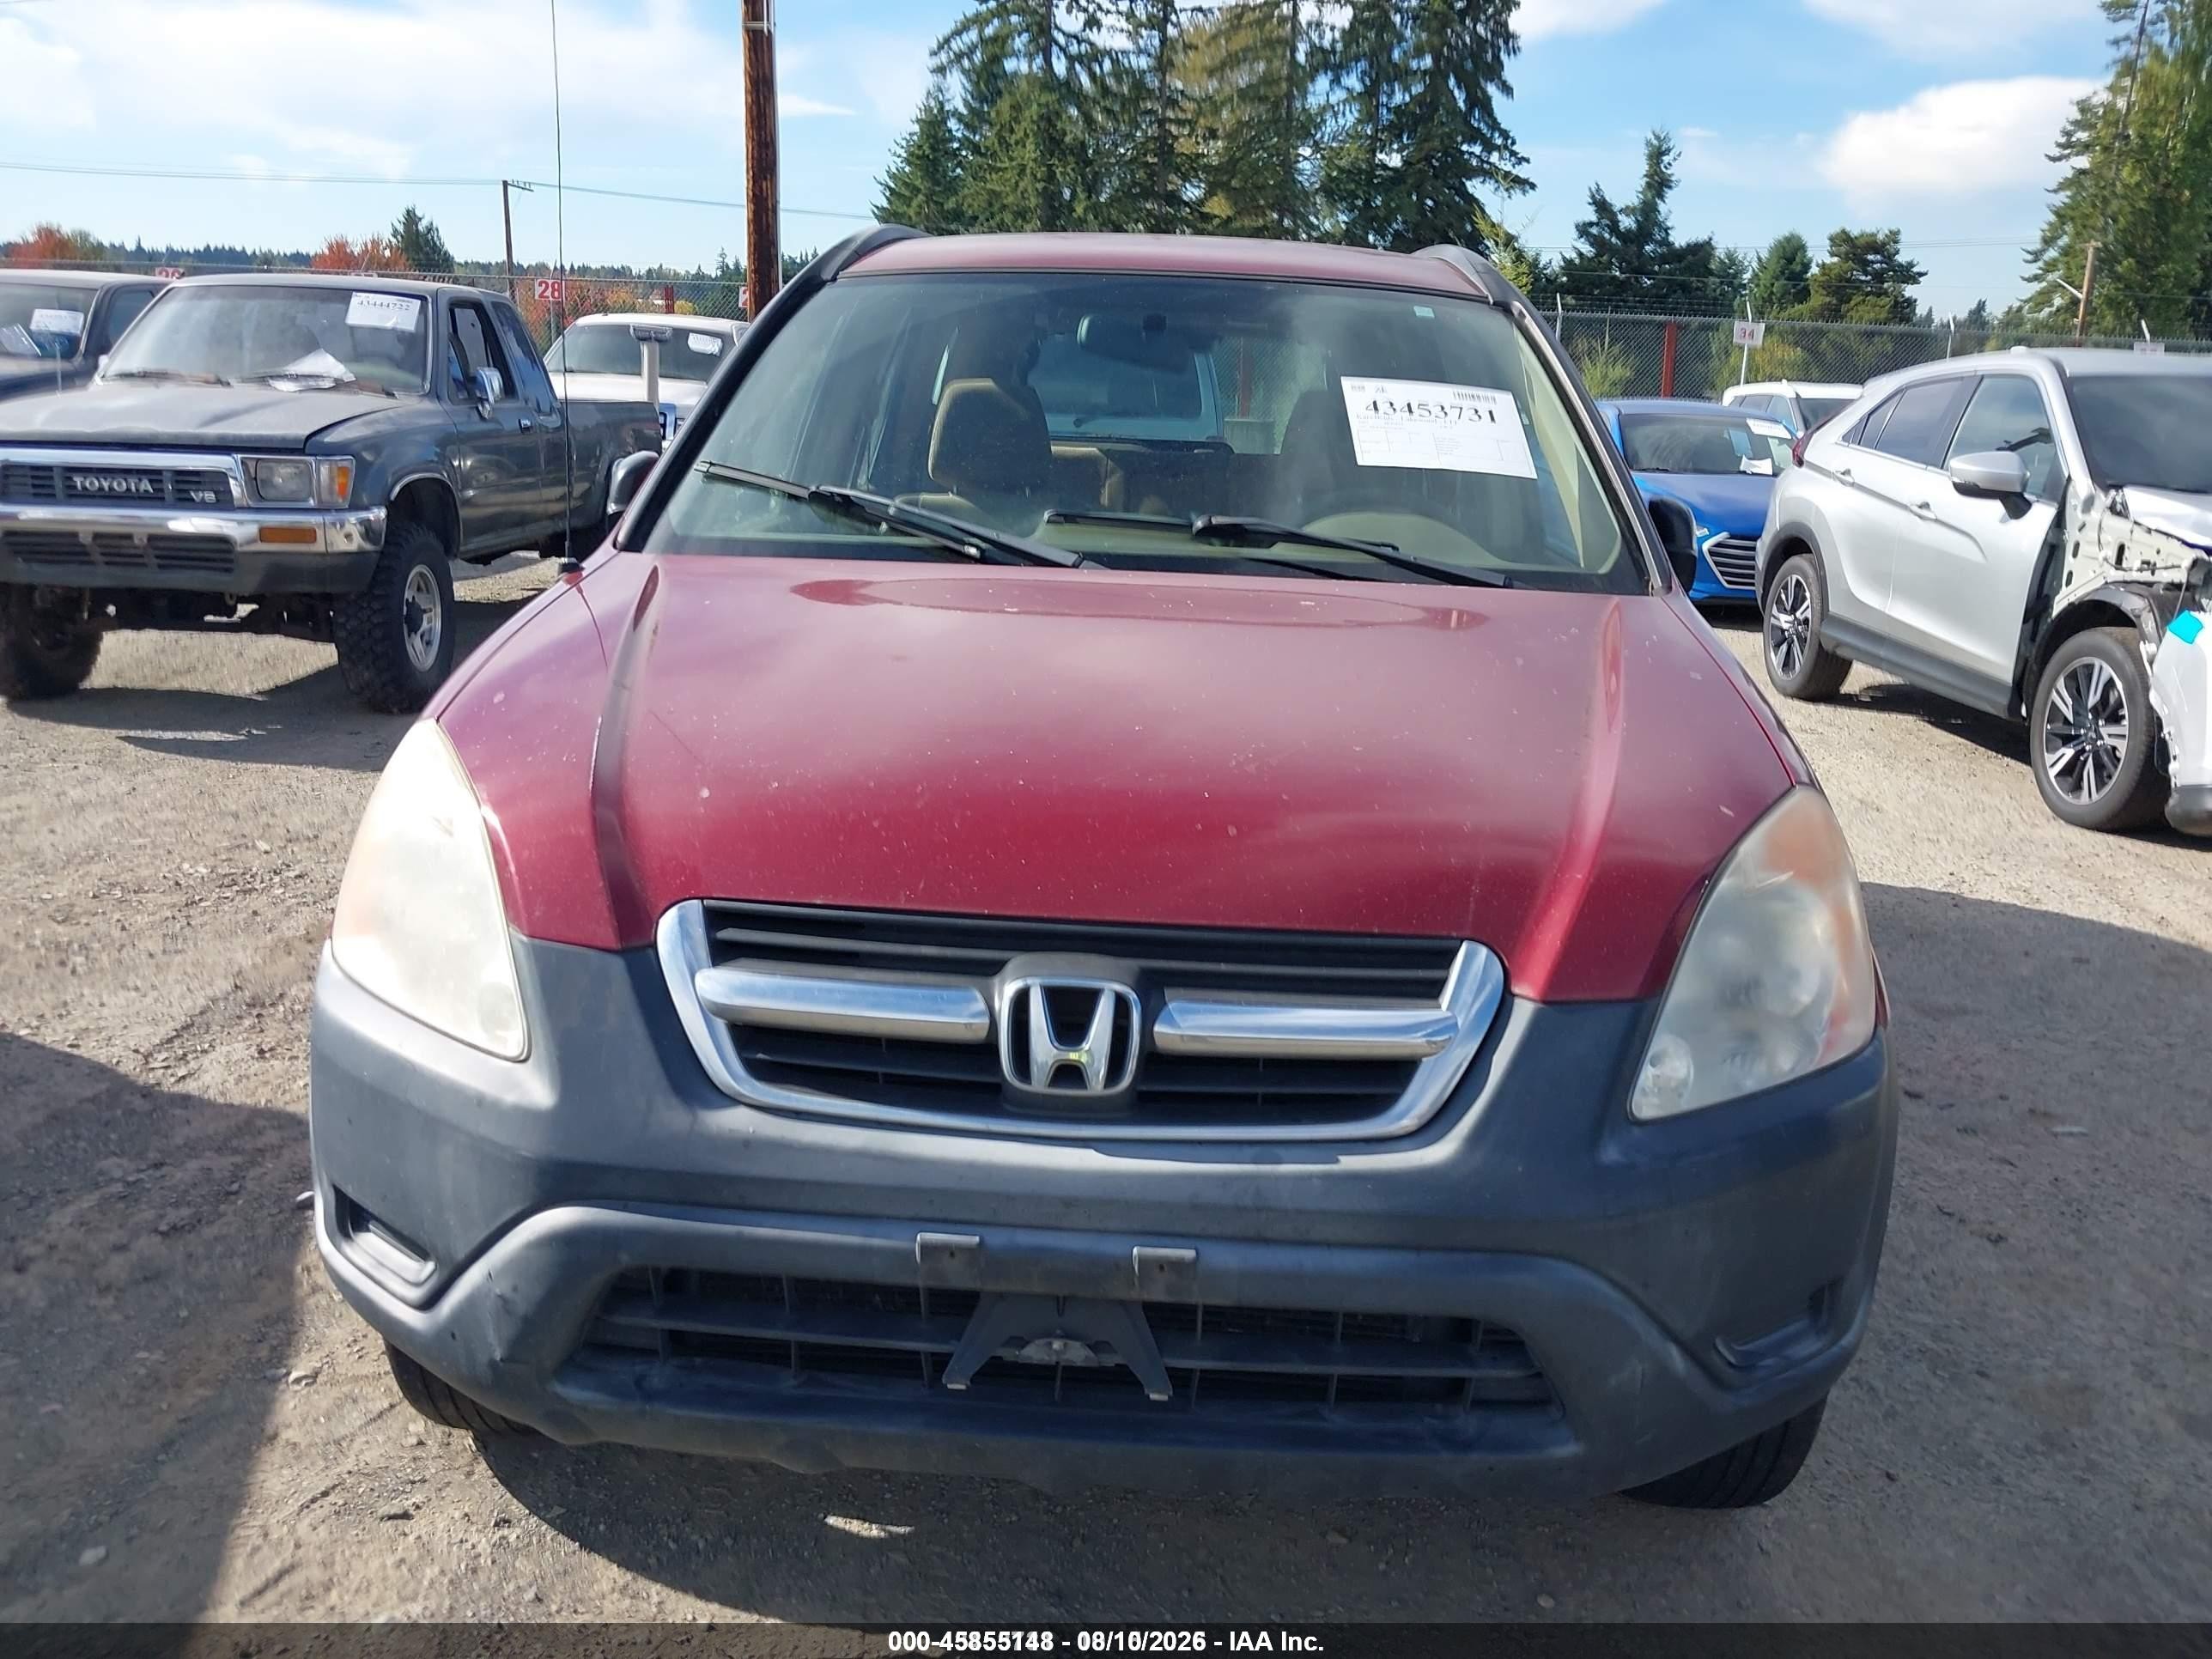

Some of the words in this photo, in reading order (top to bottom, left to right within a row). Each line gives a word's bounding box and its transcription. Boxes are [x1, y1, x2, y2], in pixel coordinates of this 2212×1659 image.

[538, 280, 562, 300] 28
[1365, 399, 1497, 424] 43453731
[72, 476, 154, 494] TOYOTA
[190, 490, 217, 503] V6
